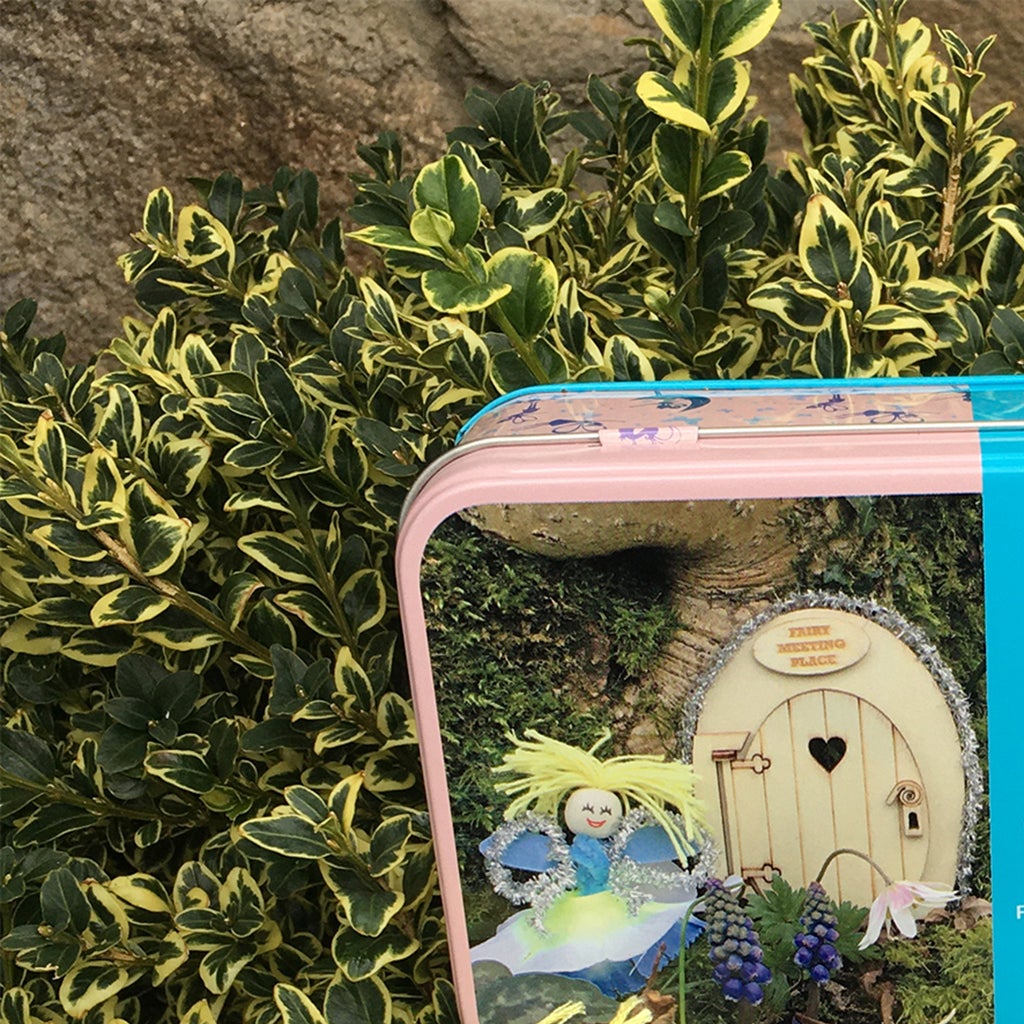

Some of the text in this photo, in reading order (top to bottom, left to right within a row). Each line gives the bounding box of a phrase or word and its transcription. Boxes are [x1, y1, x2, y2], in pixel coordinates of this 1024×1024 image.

[788, 625, 831, 638] FAIRY
[777, 639, 846, 654] MEETING
[790, 655, 837, 667] PLACE
